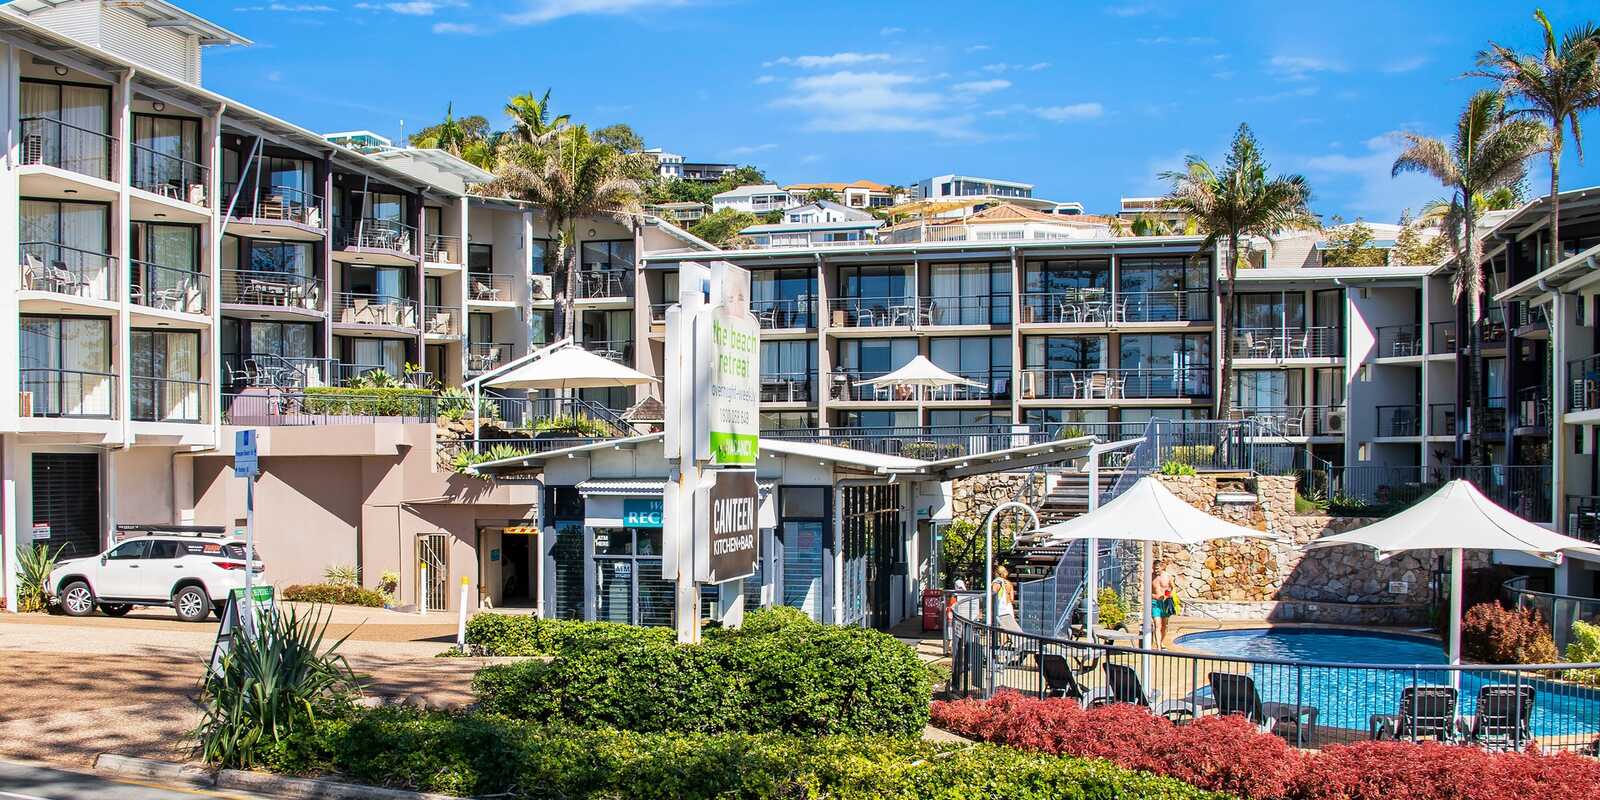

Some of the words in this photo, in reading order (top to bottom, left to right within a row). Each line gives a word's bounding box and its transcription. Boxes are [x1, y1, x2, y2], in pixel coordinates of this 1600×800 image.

[713, 319, 727, 346] the
[730, 323, 757, 353] beach
[719, 354, 750, 377] retreat
[713, 496, 754, 535] CANTEEN
